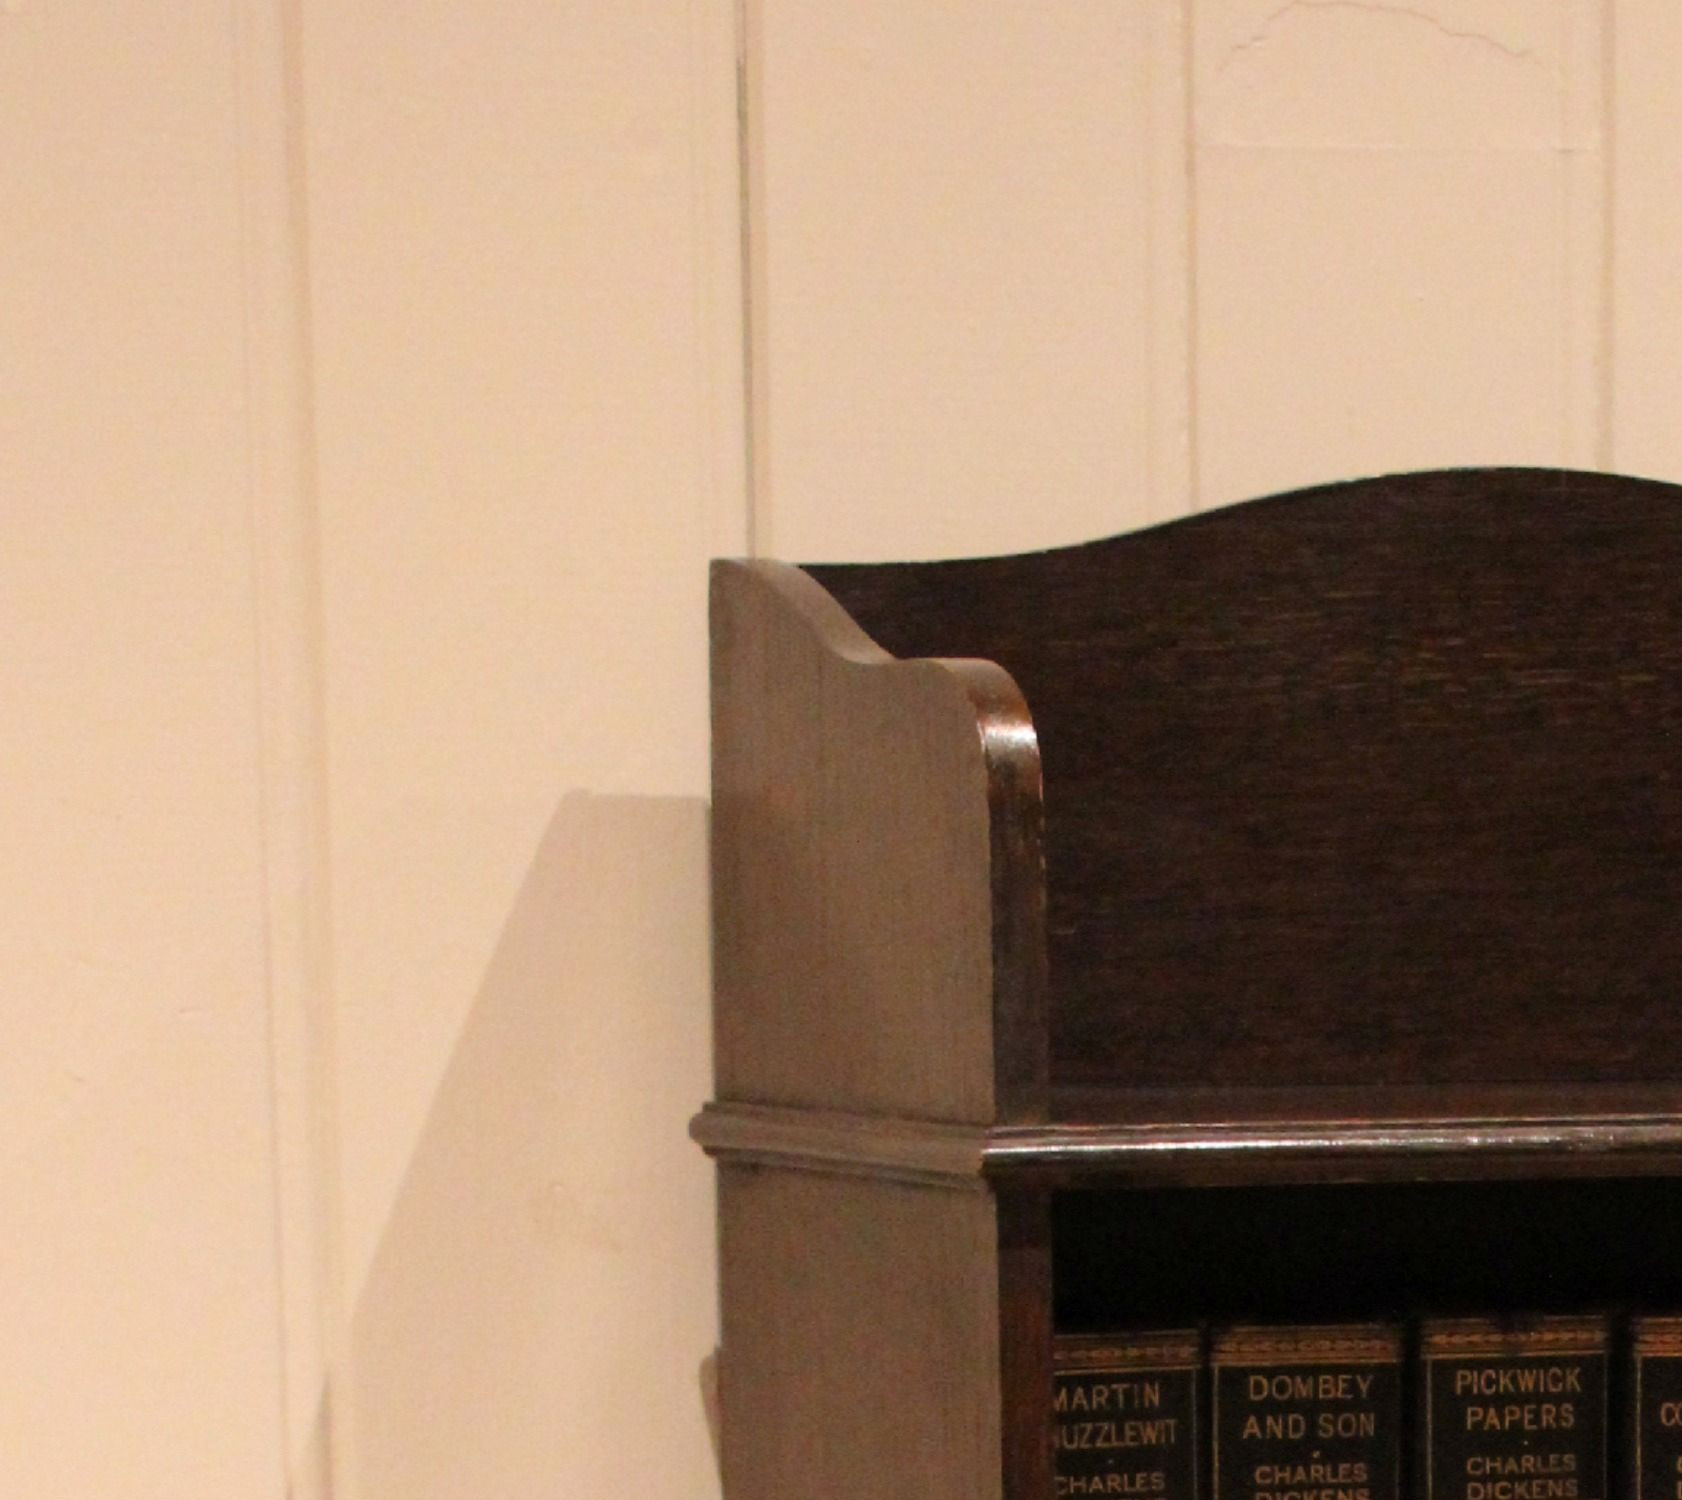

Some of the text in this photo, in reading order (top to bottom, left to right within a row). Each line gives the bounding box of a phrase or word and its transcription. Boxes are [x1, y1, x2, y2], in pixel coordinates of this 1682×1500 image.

[1248, 1374, 1375, 1402] DOMBEY
[1454, 1366, 1581, 1395] PICKWICK
[1242, 1411, 1376, 1440] AND SON
[1466, 1402, 1576, 1431] PAPERS
[1058, 1418, 1179, 1449] UZZLEWIT
[1253, 1462, 1369, 1486] CHARLES
[1466, 1453, 1577, 1476] CHARLES
[1057, 1471, 1166, 1496] CHARLES
